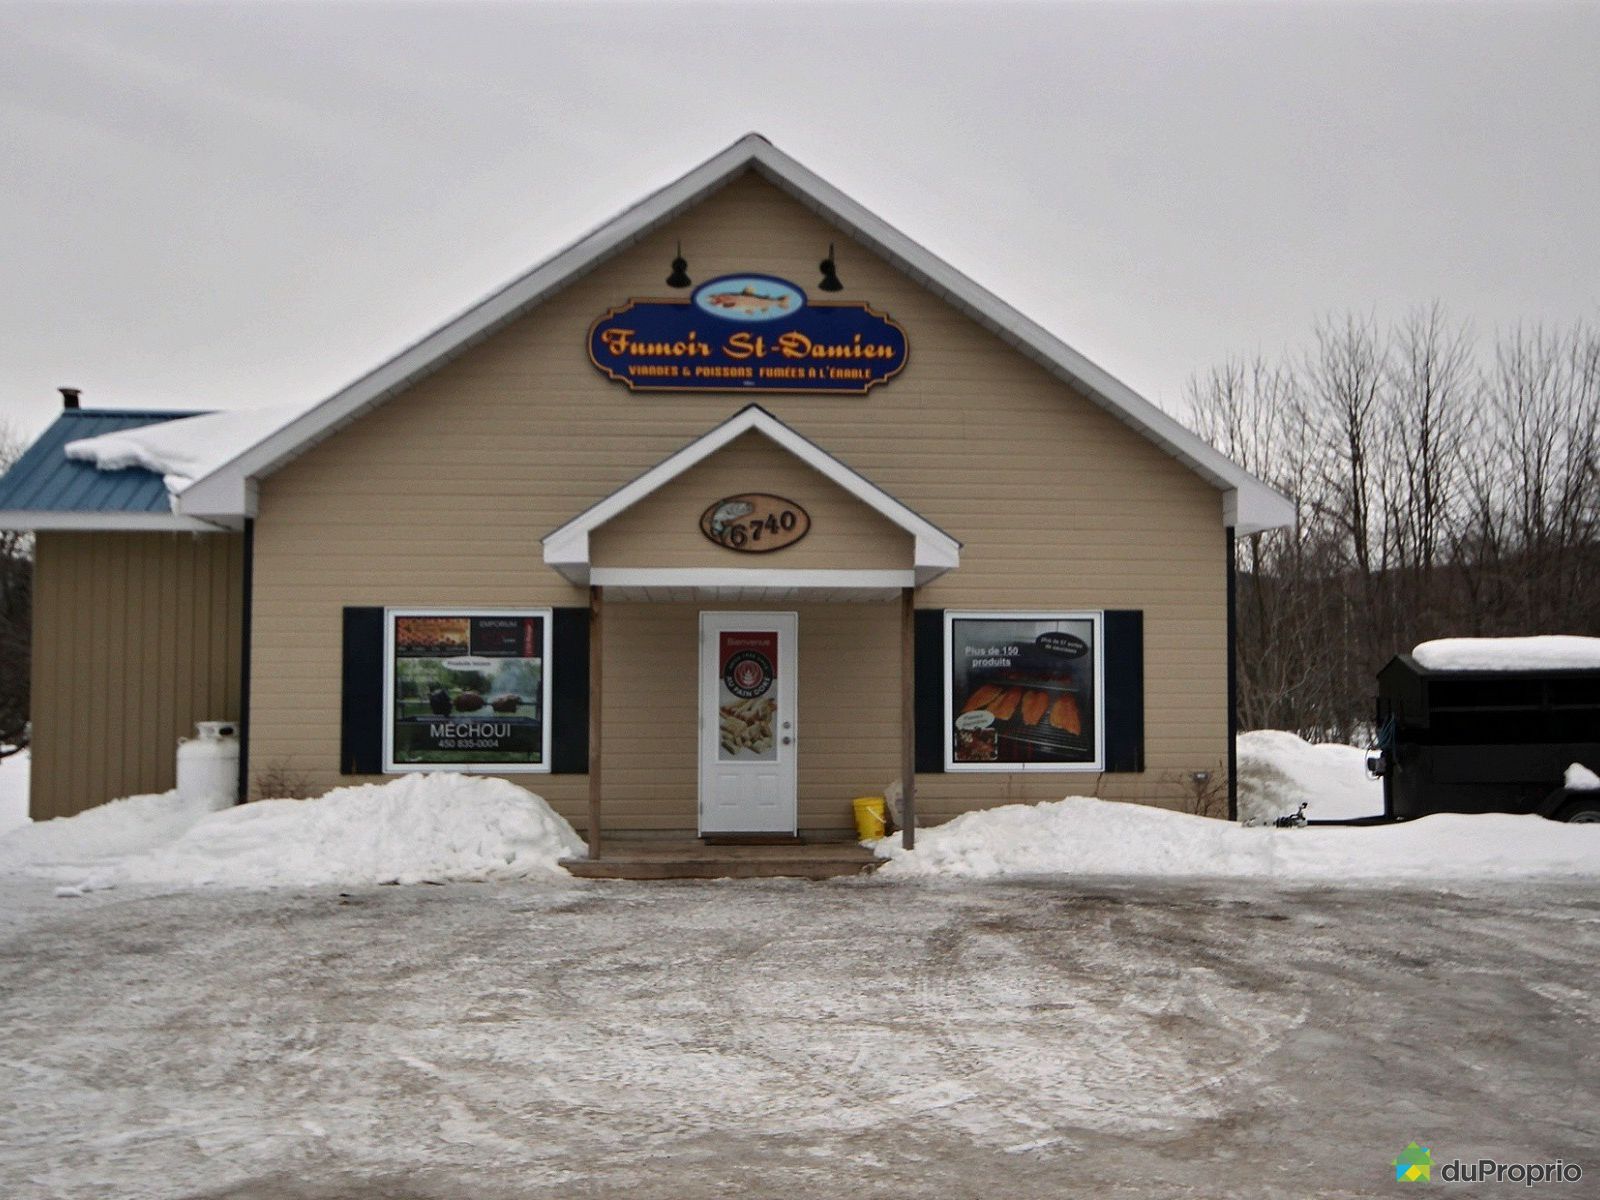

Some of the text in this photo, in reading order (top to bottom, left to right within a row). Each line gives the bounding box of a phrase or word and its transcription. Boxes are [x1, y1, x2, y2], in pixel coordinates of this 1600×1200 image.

[601, 328, 895, 359] Fumoir St-Damien
[628, 365, 679, 377] VIANDES
[682, 366, 691, 377] &
[695, 366, 753, 378] POISSONS
[731, 510, 796, 547] 6740
[965, 646, 1019, 656] Plus de 150
[972, 658, 1011, 668] produits
